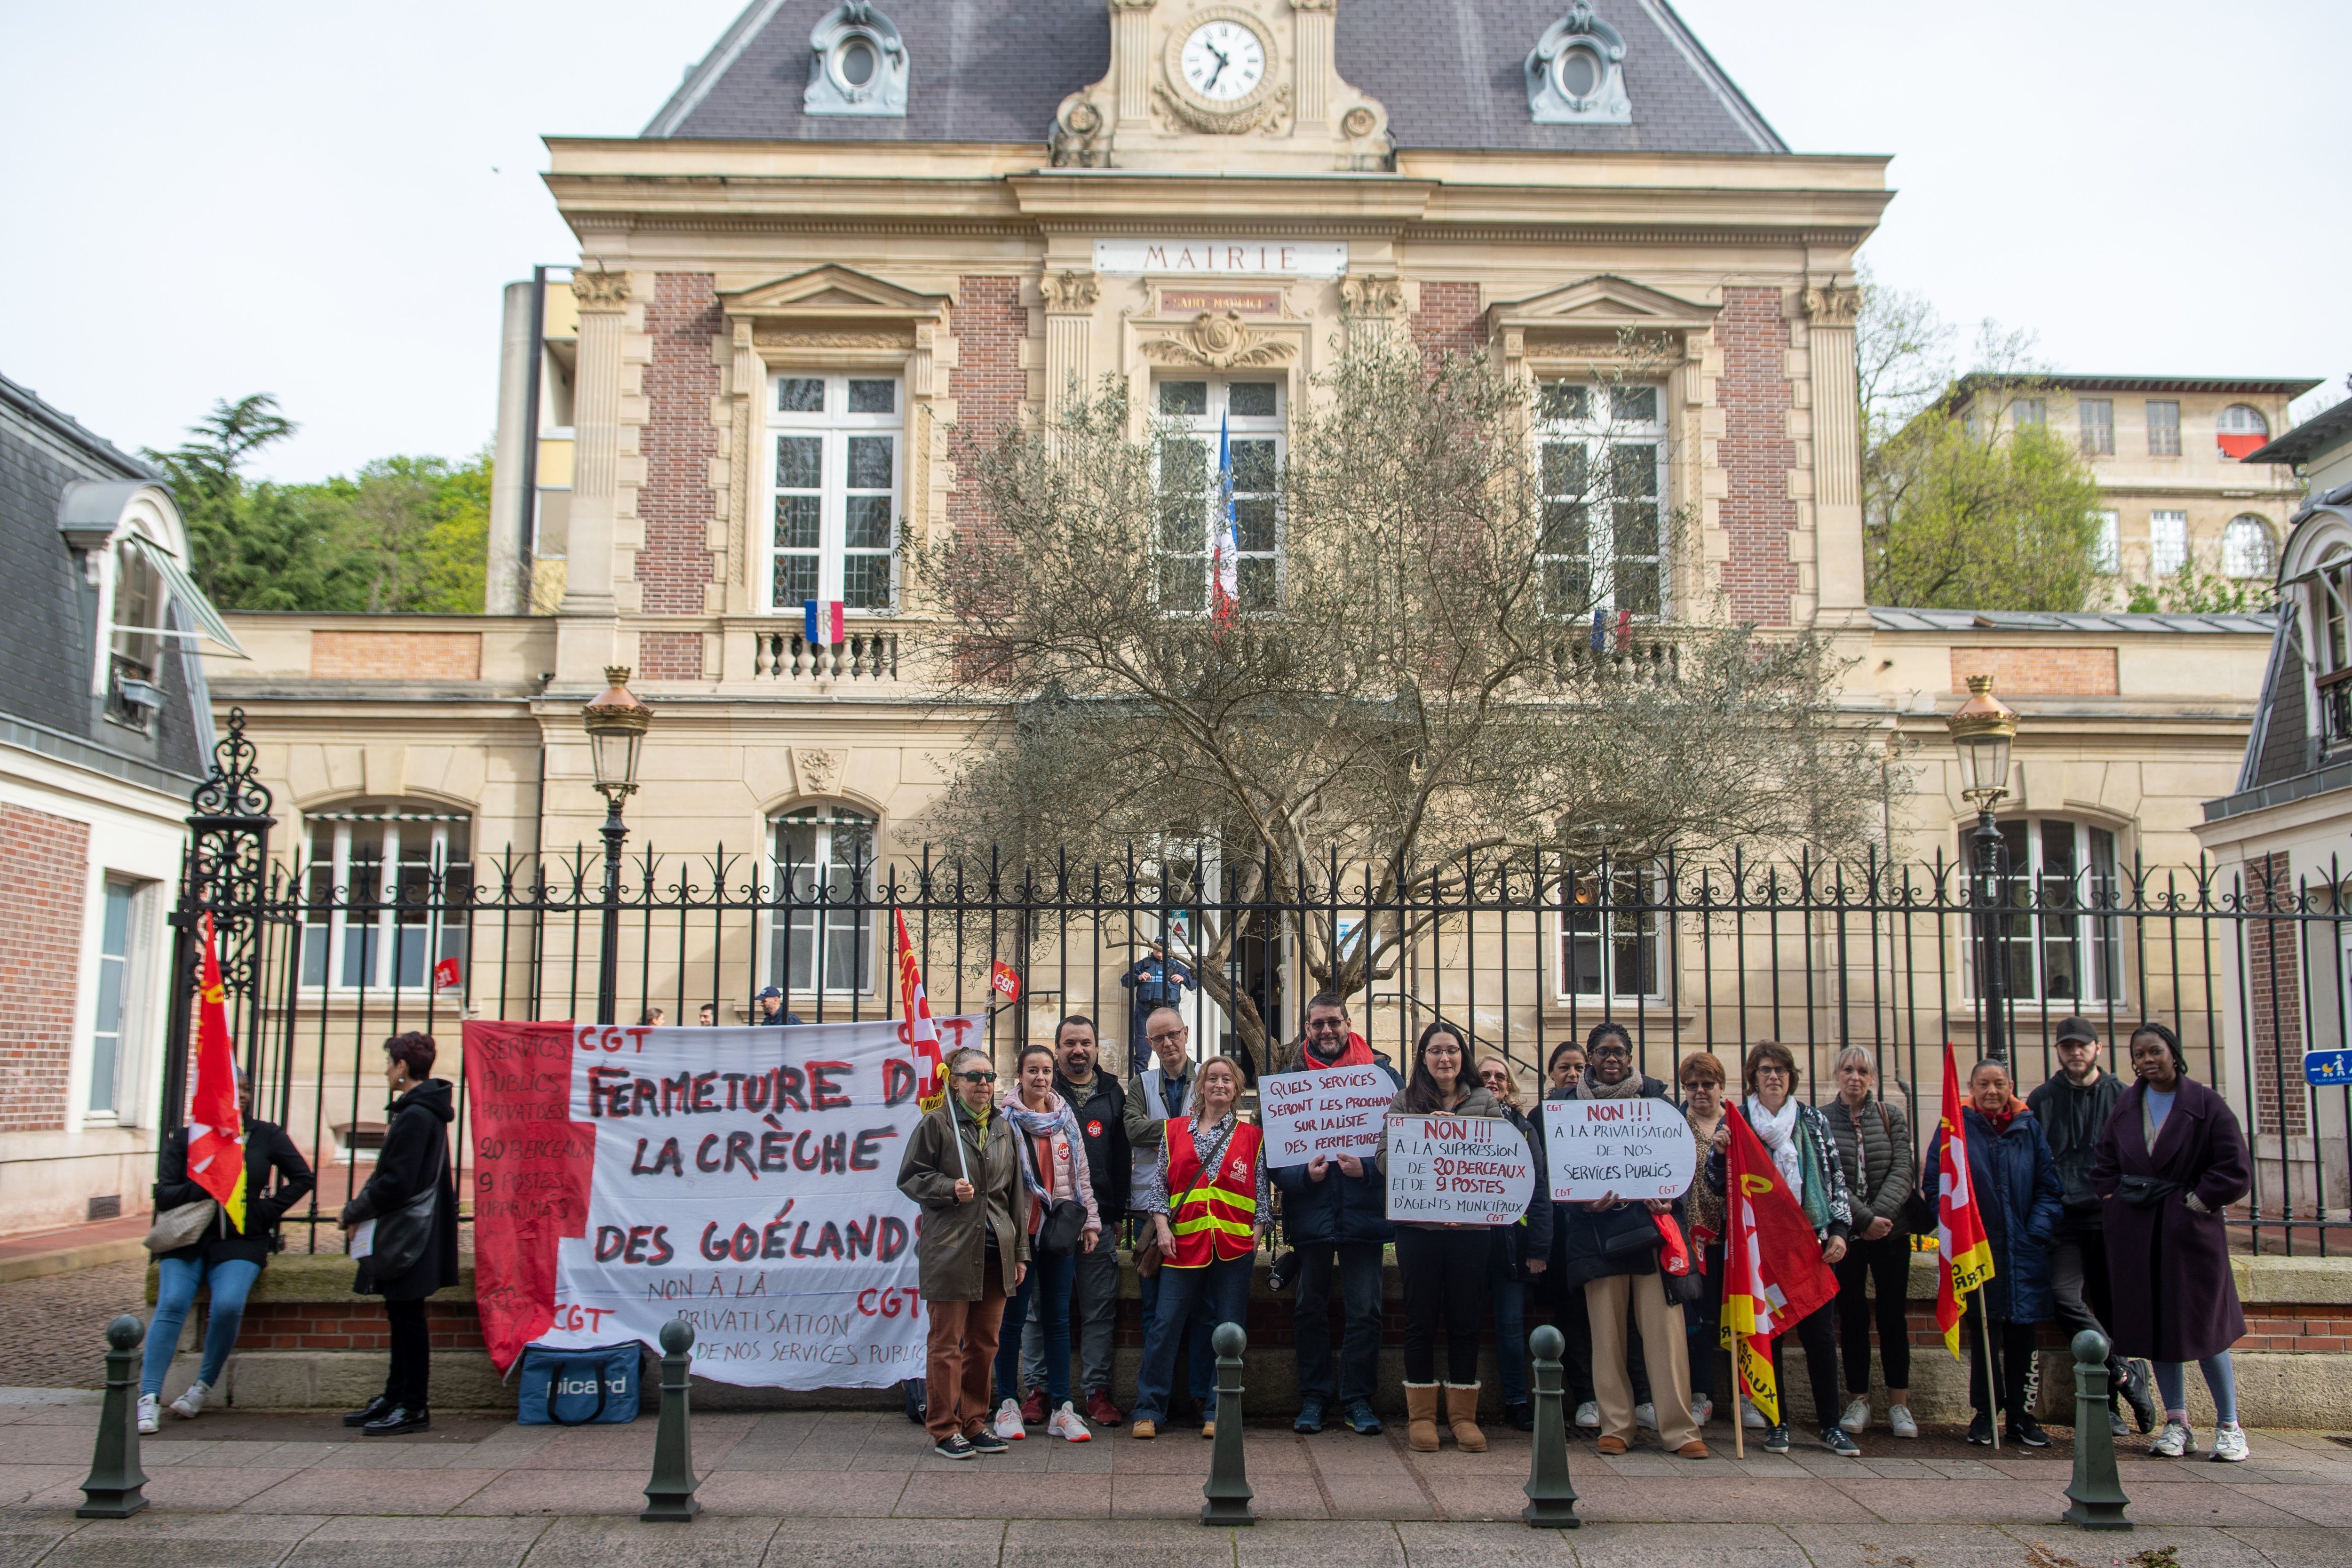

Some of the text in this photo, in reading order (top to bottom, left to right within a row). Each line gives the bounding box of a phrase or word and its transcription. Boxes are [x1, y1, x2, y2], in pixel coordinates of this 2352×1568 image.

[1144, 245, 1297, 270] MAIRIE
[995, 974, 1015, 994] cgt
[485, 1033, 567, 1060] SERVICES
[578, 1026, 653, 1053] CGT
[482, 1068, 561, 1093] PUBLICS
[588, 1058, 916, 1119] FERMETURE D
[1271, 1073, 1376, 1099] QUELS SERVICES
[1268, 1098, 1313, 1118] SERONT
[1320, 1099, 1343, 1111] LES
[1588, 1101, 1651, 1122] NON !!!
[1294, 1119, 1318, 1132] SUR
[1321, 1118, 1335, 1130] LA
[1336, 1113, 1368, 1130] LISTE
[1390, 1118, 1405, 1127] CGT
[1424, 1119, 1492, 1143] NON !!!
[1571, 1124, 1588, 1137] LA
[1594, 1122, 1682, 1138] PRIVATISATION
[479, 1137, 594, 1161] 20 BERCEAUX
[630, 1114, 899, 1181] LA CRÈCHE
[1059, 1146, 1069, 1157] cgt
[1285, 1139, 1307, 1155] DES
[1413, 1141, 1432, 1155] LA
[1439, 1142, 1518, 1157] SUPPRESSION
[1597, 1144, 1652, 1156] DE NOS
[1232, 1161, 1247, 1174] cgt
[1408, 1157, 1526, 1178] DE 20 BERCEAUX
[1564, 1162, 1671, 1180] SERVICES PUBLICS
[479, 1171, 564, 1193] 9 POSTES
[1392, 1177, 1505, 1194] ET DE 9 POSTES
[1555, 1188, 1573, 1197] CGT
[1659, 1185, 1678, 1194] CGT
[1394, 1195, 1523, 1213] D'AGENTS MUNICIPAUX
[1486, 1213, 1508, 1222] CGT
[596, 1225, 674, 1266] DES
[648, 1273, 693, 1302] NON
[857, 1286, 920, 1319] CGT
[553, 1301, 617, 1333] CGT
[677, 1308, 850, 1337] PRIVATISATION
[770, 1341, 858, 1366] SERVICES
[869, 1342, 927, 1365] PUBLIC
[2023, 1349, 2039, 1412] adidas
